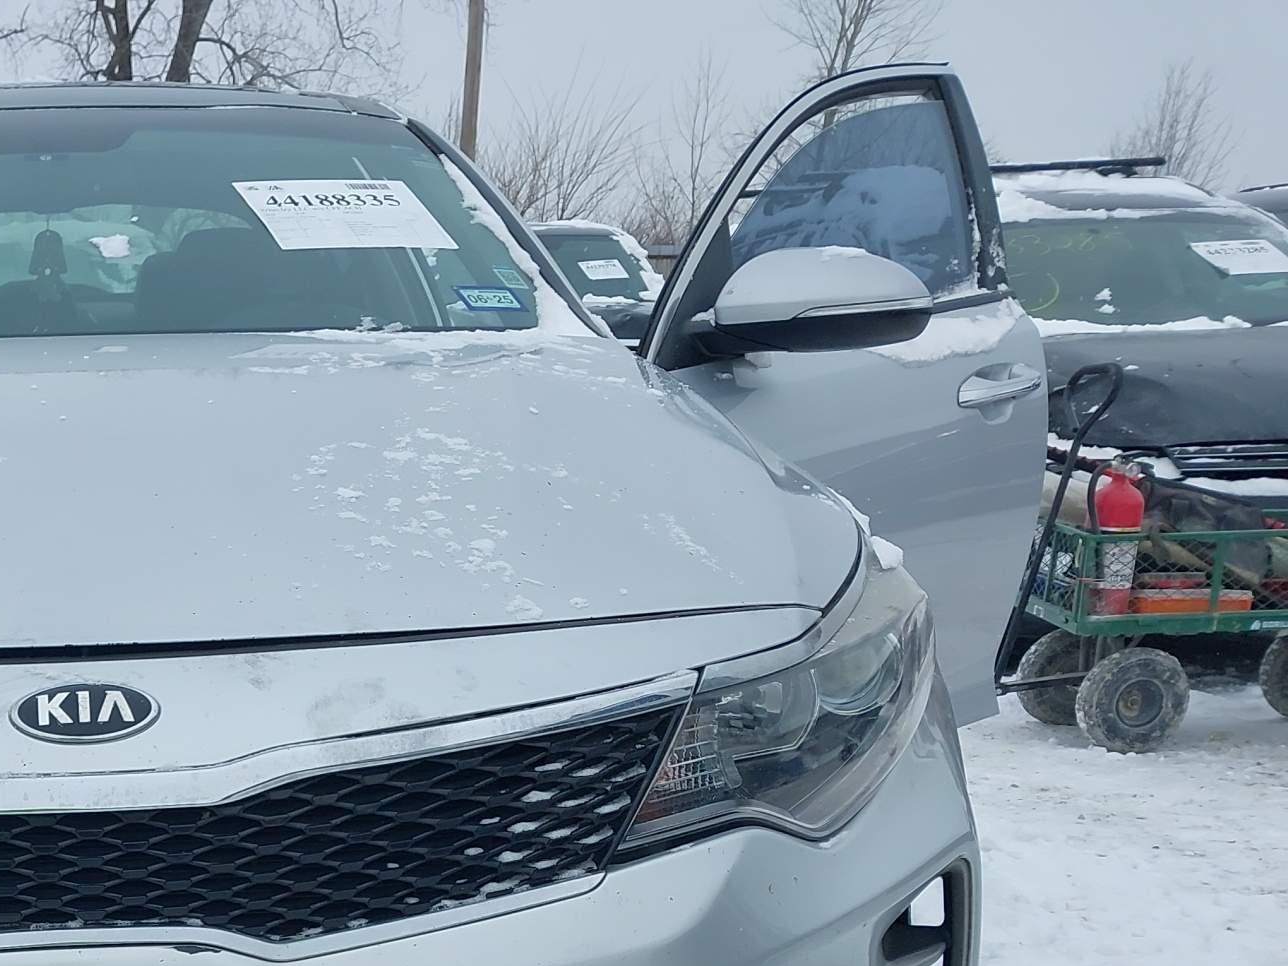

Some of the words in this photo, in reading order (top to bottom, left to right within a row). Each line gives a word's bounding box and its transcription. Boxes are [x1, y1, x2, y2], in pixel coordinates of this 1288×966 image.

[266, 194, 401, 207] 44188335
[466, 294, 488, 304] 06
[493, 294, 514, 305] 25
[35, 690, 136, 727] KIA
